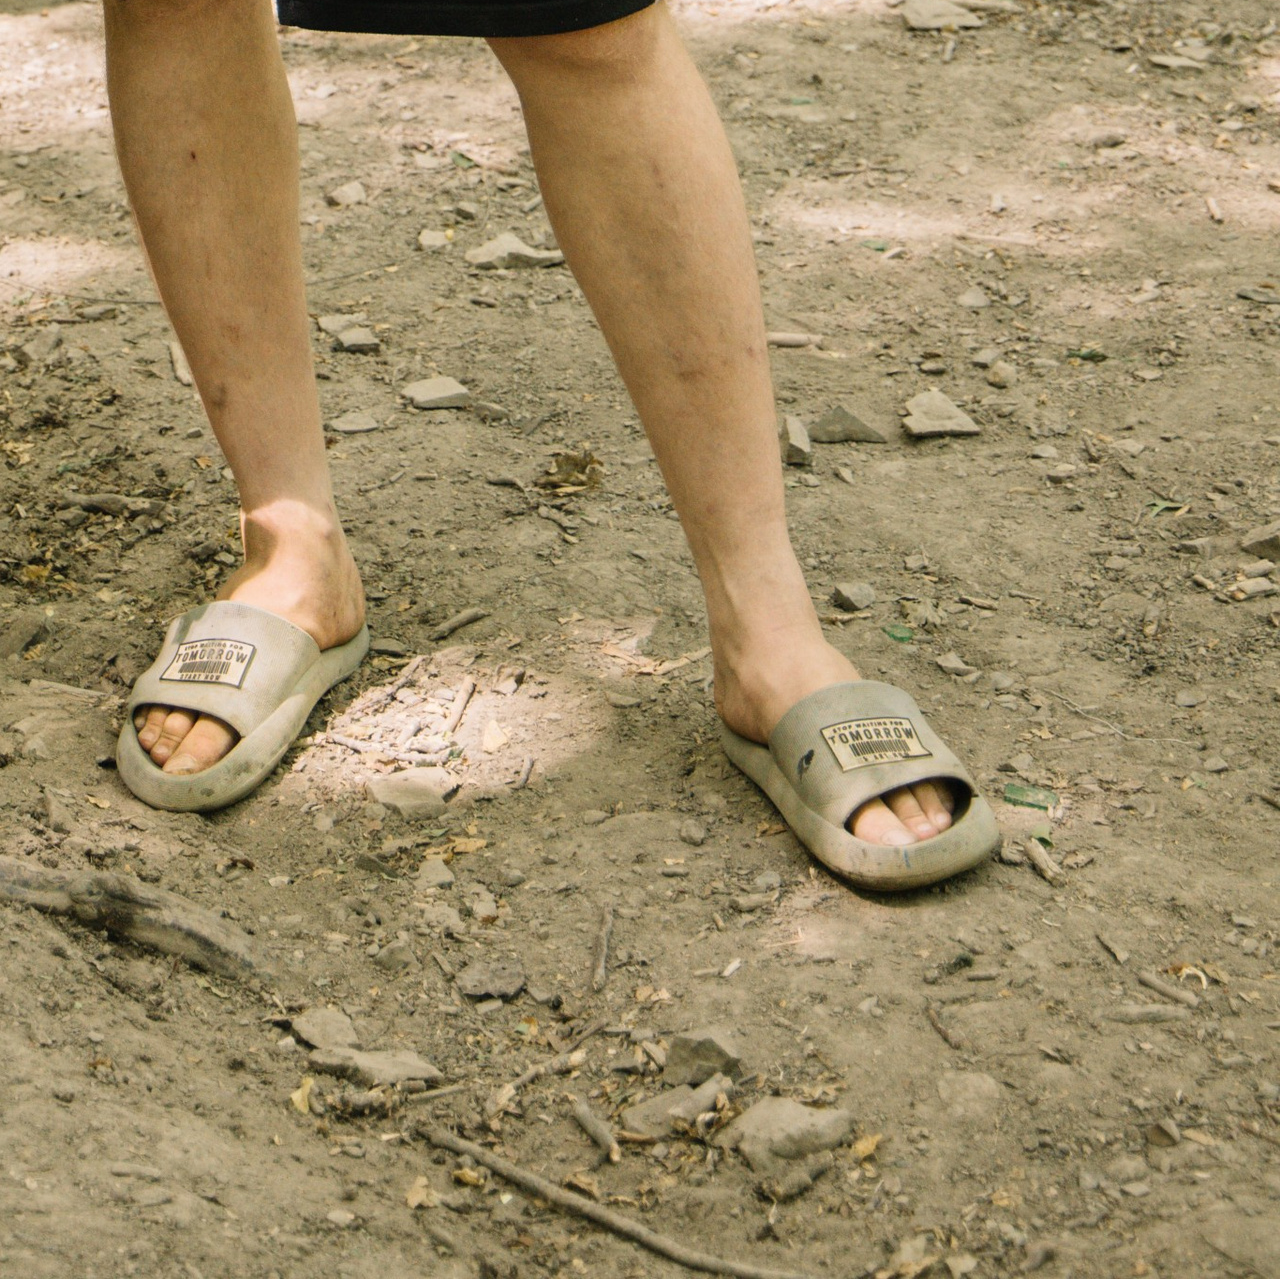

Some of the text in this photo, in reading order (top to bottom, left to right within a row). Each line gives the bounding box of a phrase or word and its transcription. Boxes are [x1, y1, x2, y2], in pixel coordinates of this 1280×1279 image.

[176, 649, 248, 664] TOMORROW
[855, 721, 888, 729] WAITING
[827, 727, 914, 745] TOMORROW
